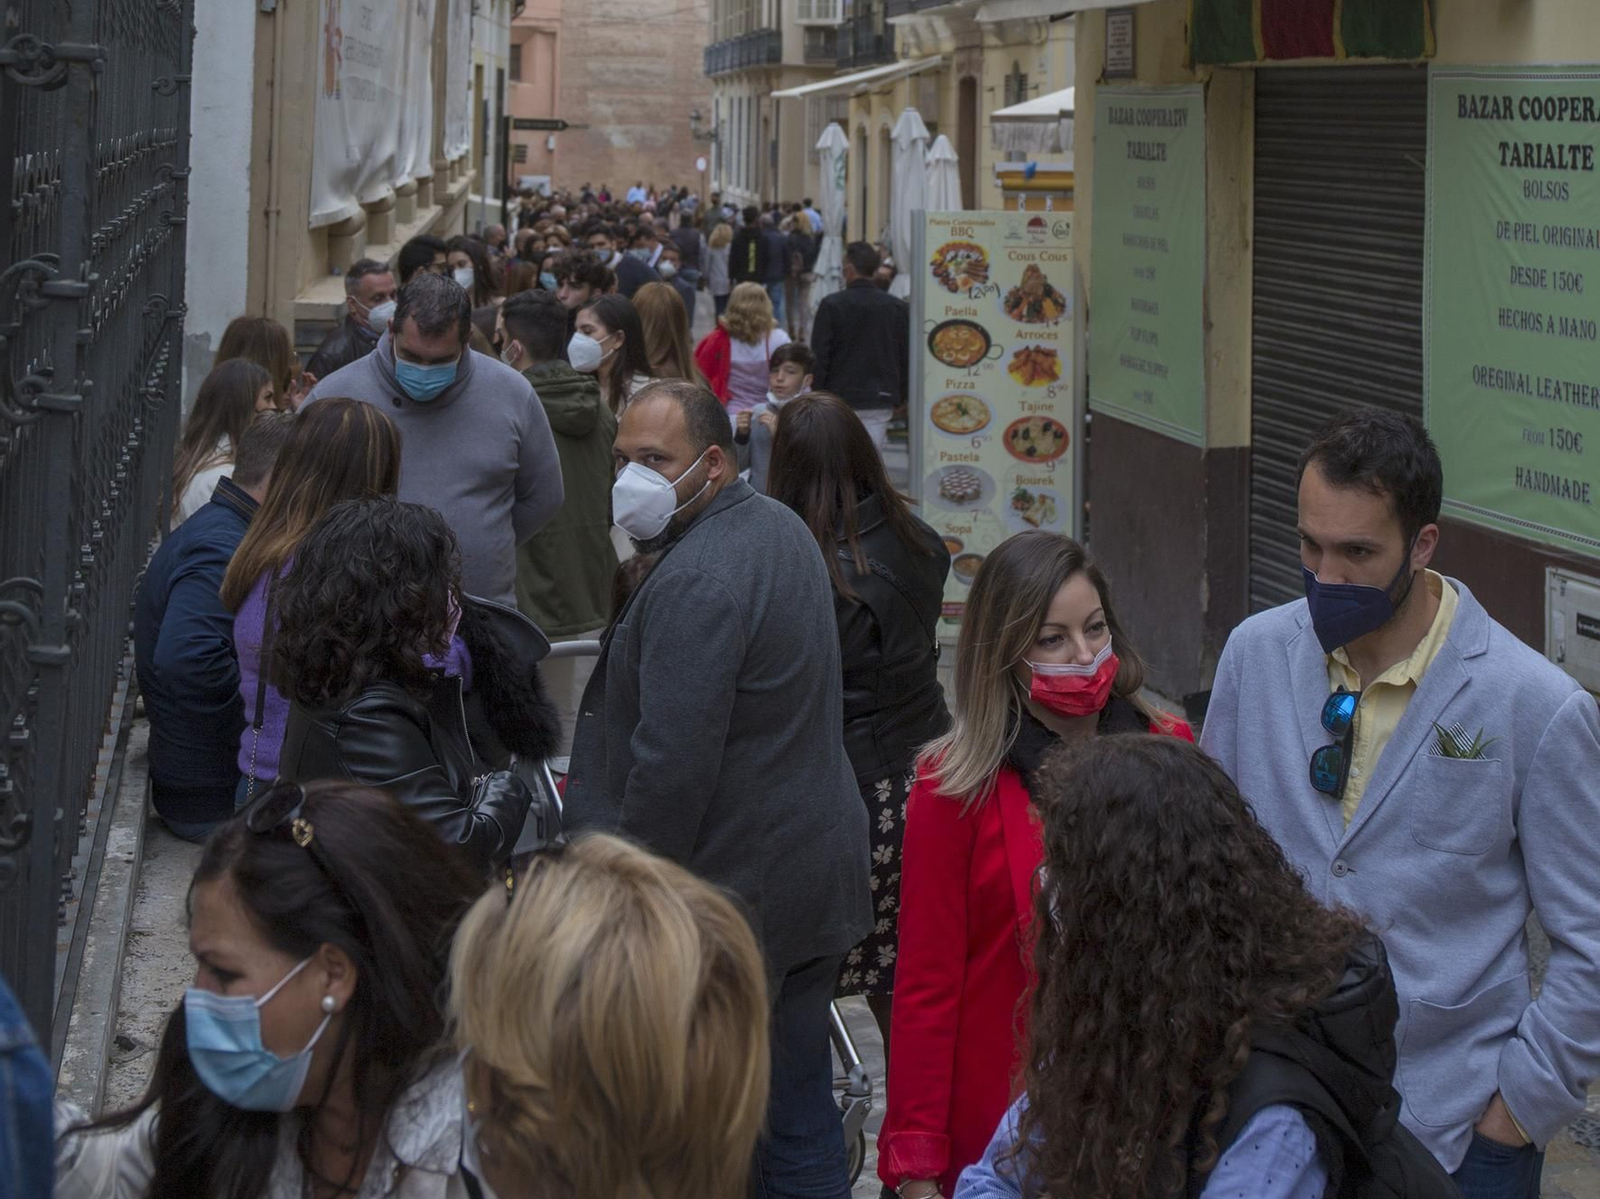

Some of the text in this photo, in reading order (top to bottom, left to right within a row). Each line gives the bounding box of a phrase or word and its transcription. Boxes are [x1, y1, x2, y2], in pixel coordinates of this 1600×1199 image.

[1108, 107, 1134, 126] BAZAR
[1458, 94, 1600, 122] BAZAR COOPER
[1498, 141, 1594, 171] TARIALTE
[1523, 179, 1570, 200] BOLSOS
[951, 227, 974, 238] BBQ
[1496, 221, 1511, 240] DE
[1514, 222, 1539, 243] PIEL
[1008, 251, 1067, 261] Cous Cous
[1510, 265, 1583, 293] DESDE 150€
[945, 306, 978, 317] Paella
[1498, 307, 1597, 340] HECHOS A MANO
[1015, 330, 1059, 340] Arroces
[945, 379, 975, 389] Pizza
[1472, 364, 1533, 395] OREGINAL
[1019, 401, 1054, 413] Tajine
[1523, 427, 1583, 452] FROM 150€
[940, 452, 980, 462] Pastela
[1016, 475, 1055, 485] Bourek
[1515, 466, 1590, 504] HANDMADE
[945, 524, 972, 535] Sopa
